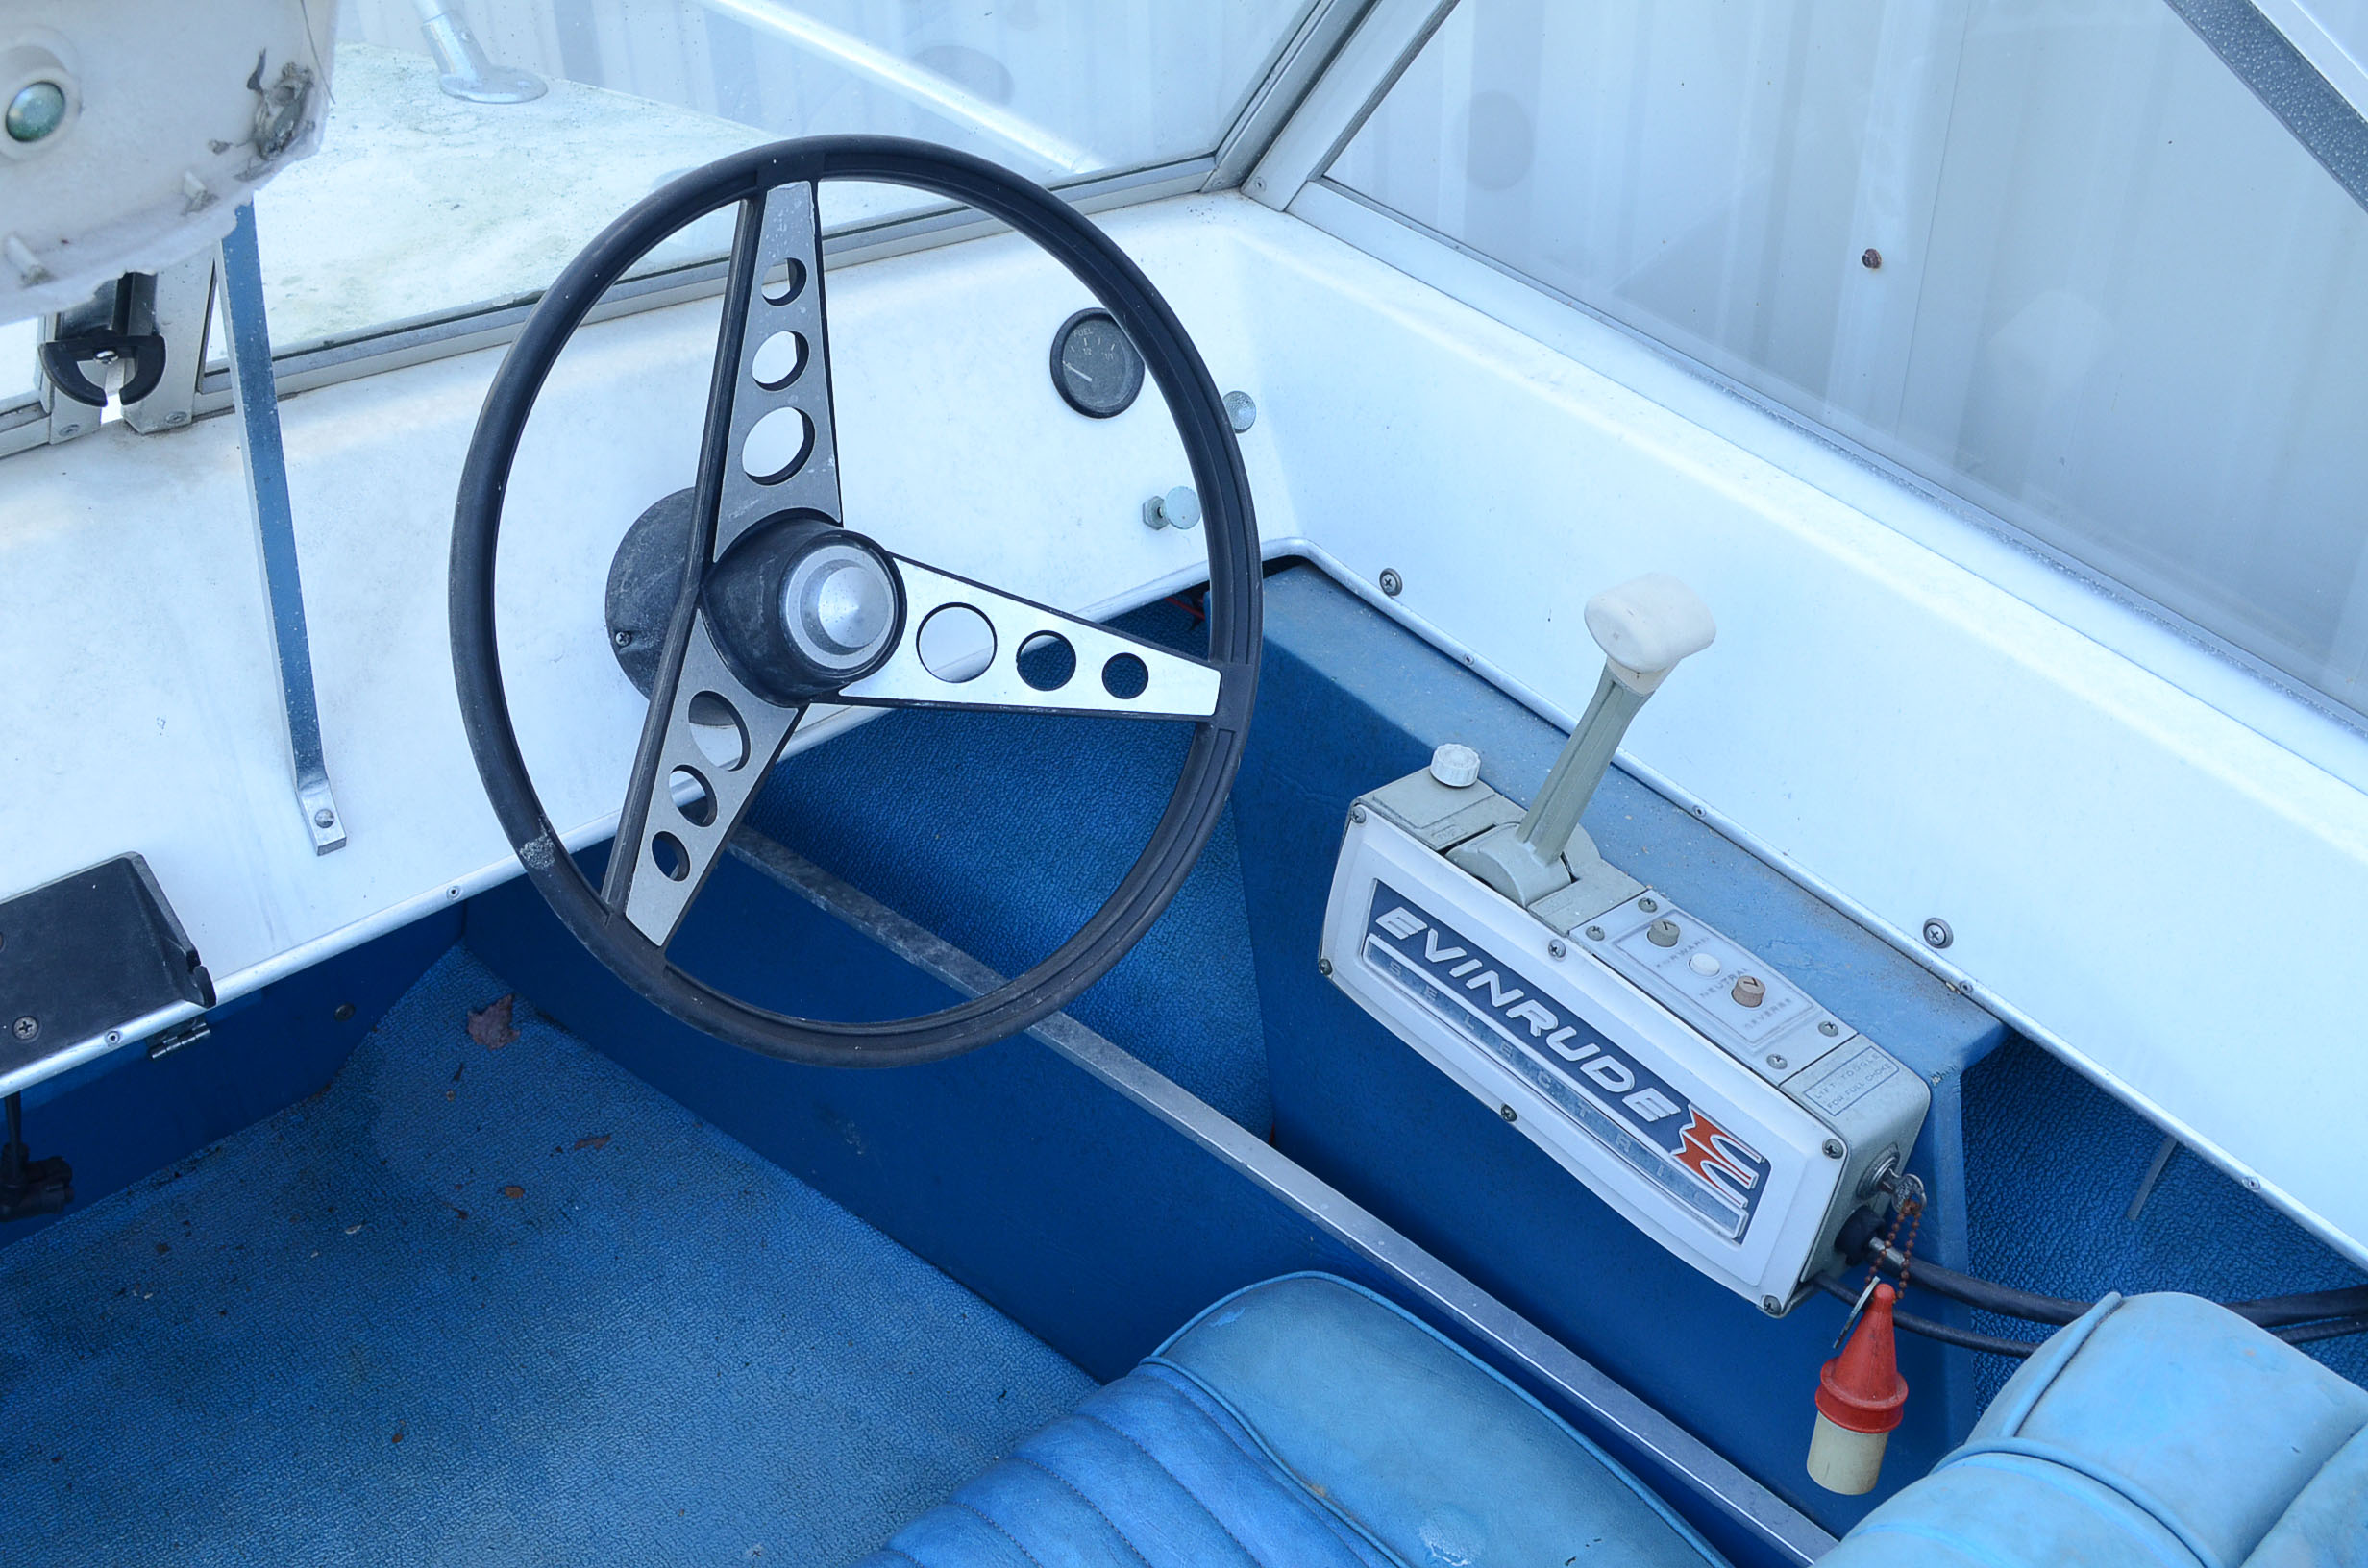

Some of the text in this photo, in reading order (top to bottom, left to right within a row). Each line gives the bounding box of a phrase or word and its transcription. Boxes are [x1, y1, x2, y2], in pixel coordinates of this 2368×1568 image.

[1073, 328, 1094, 338] FUEL
[1375, 906, 1682, 1123] EVINRUDE
[1827, 1063, 1892, 1109] FOR FULL CHOKE
